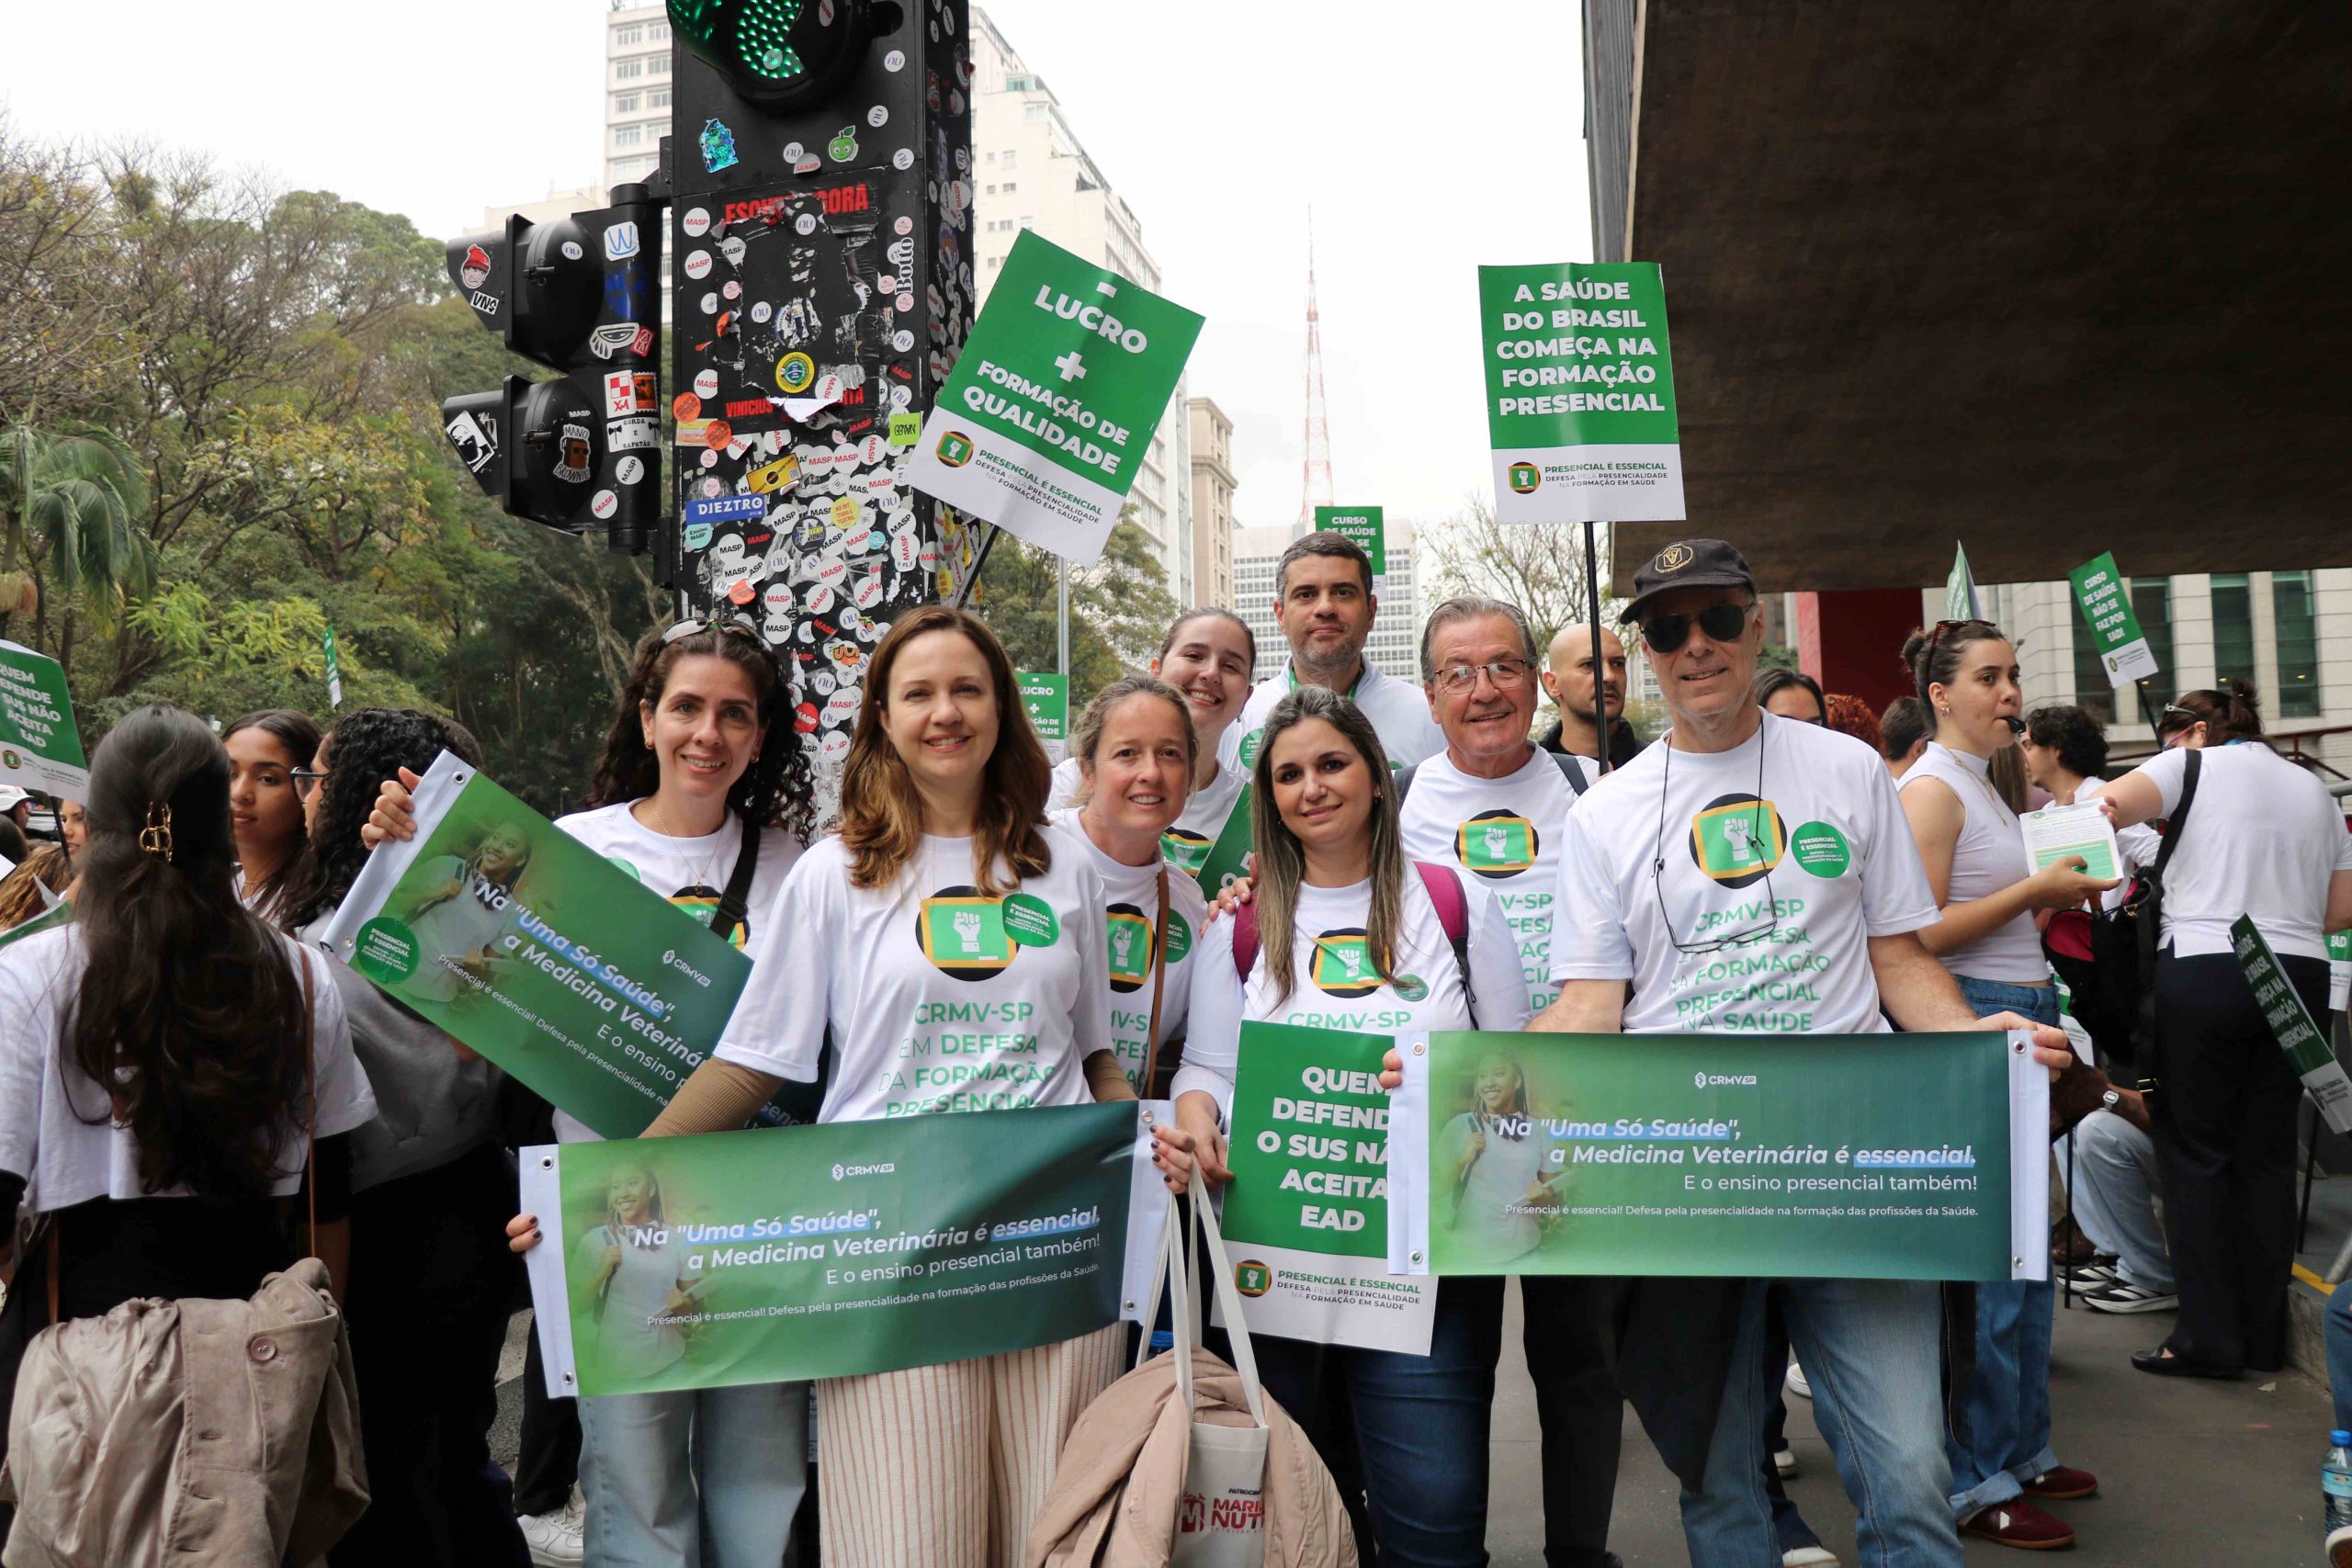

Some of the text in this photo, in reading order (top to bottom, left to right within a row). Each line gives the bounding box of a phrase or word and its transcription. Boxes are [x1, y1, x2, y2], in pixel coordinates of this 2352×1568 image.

[687, 258, 709, 270] MASP
[895, 237, 914, 294] Botto
[1514, 277, 1630, 302] A SAÚDE
[1034, 284, 1148, 354] LUCRO
[1503, 309, 1646, 331] DO BRASIL
[1496, 336, 1657, 360] COMEÇA NA
[1502, 360, 1656, 388] FORMAÇÃO
[726, 400, 774, 418] VINICIUS
[977, 360, 1130, 446] FORMAÇÃO DE
[1499, 393, 1665, 415] PRESENCIAL
[565, 427, 588, 439] MANO
[963, 385, 1122, 475] QUALIDADE
[1544, 463, 1606, 473] PRESENCIAL
[869, 479, 892, 488] MASP
[976, 459, 1100, 524] DEFESA PRESENCIALIDADE
[979, 449, 1102, 515] PRESENCIAL É ESSENCIAL
[698, 497, 763, 515] DIEZTRO
[883, 497, 897, 507] nu
[998, 479, 1055, 511] FORMAÇÃO EM
[890, 514, 910, 534] MASP
[1340, 526, 1376, 536] SAÚDE
[719, 545, 742, 554] MASP
[747, 534, 771, 545] MASP
[901, 536, 910, 560] MASP
[820, 565, 843, 580] MASP
[2084, 571, 2108, 590] CURSO
[2084, 582, 2118, 606] DE SAÚDE
[2092, 598, 2119, 617] NÃO SE
[2096, 611, 2126, 632] FAZ POR
[0, 678, 52, 705] EFENDE
[2, 693, 62, 722] SUS NÃO
[6, 709, 54, 736] ACEITA
[20, 728, 46, 748] EAD
[1694, 898, 1804, 933] CRMV-SP
[475, 882, 676, 1022] Na "Uma Só Saúde",
[2330, 936, 2346, 948] EAD
[504, 935, 522, 950] a
[521, 943, 618, 1013] Medicina
[673, 958, 700, 980] CRMV
[1694, 950, 1830, 986] FORMAÇÃO
[1675, 982, 1821, 1017] PRESENCIAL
[914, 1001, 1033, 1025] CRMV-SP
[1286, 1010, 1412, 1030] CRMV-SP
[1724, 1008, 1813, 1032] SAÚDE
[438, 954, 486, 989] Presencial
[492, 991, 537, 1022] essencial!
[537, 1018, 567, 1043] Defesa
[567, 1039, 587, 1056] pela
[587, 1051, 656, 1099] presencialidade
[597, 1023, 612, 1040] E
[611, 1035, 623, 1047] o
[625, 1042, 676, 1081] ensino
[899, 1033, 1038, 1058] EM DEFESA
[878, 1061, 1055, 1092] DA FORMAÇÃO
[1709, 1075, 1742, 1085] CRMV
[1498, 1117, 1741, 1140] Na "Uma Só Saúde",
[1257, 1131, 1282, 1153] O
[1288, 1134, 1348, 1161] SUS
[1550, 1144, 1976, 1165] a Medicina Veterinária é essencial.
[846, 1164, 879, 1177] CRMV
[1279, 1168, 1388, 1199] ACEITA
[1684, 1174, 1977, 1194] E o ensino presencial também!
[1300, 1204, 1366, 1232] EAD
[1505, 1204, 1560, 1214] Presencial
[1571, 1205, 1623, 1215] essencial!
[1625, 1205, 1662, 1215] Defesa
[1665, 1206, 1687, 1217] pela
[1690, 1205, 1775, 1217] presencialidade
[1793, 1206, 1845, 1217] formação
[1847, 1206, 1866, 1215] das
[1869, 1206, 1923, 1217] profissões
[1925, 1206, 1939, 1215] da
[1941, 1206, 1978, 1216] Saúde.
[635, 1208, 882, 1247] Na "Uma Só Saúde",
[689, 1205, 1101, 1270] a Medicina Veterinária é essencial.
[827, 1234, 1101, 1285] E o ensino presencial também!
[1277, 1281, 1420, 1304] DEFESA PRESENCIALIDADE
[1278, 1269, 1421, 1294] PRESENCIAL É ESSENCIAL
[648, 1313, 702, 1326] Presencial
[714, 1307, 766, 1321] essencial!
[769, 1305, 806, 1316] Defesa
[808, 1303, 831, 1314] pela
[834, 1293, 920, 1312] presencialidade
[922, 1291, 935, 1301] na
[937, 1281, 986, 1299] formação
[989, 1280, 1007, 1291] das
[1009, 1272, 1057, 1290] profissões
[1060, 1269, 1072, 1279] da
[1306, 1292, 1405, 1311] FORMAÇÃO EM SAÚDE
